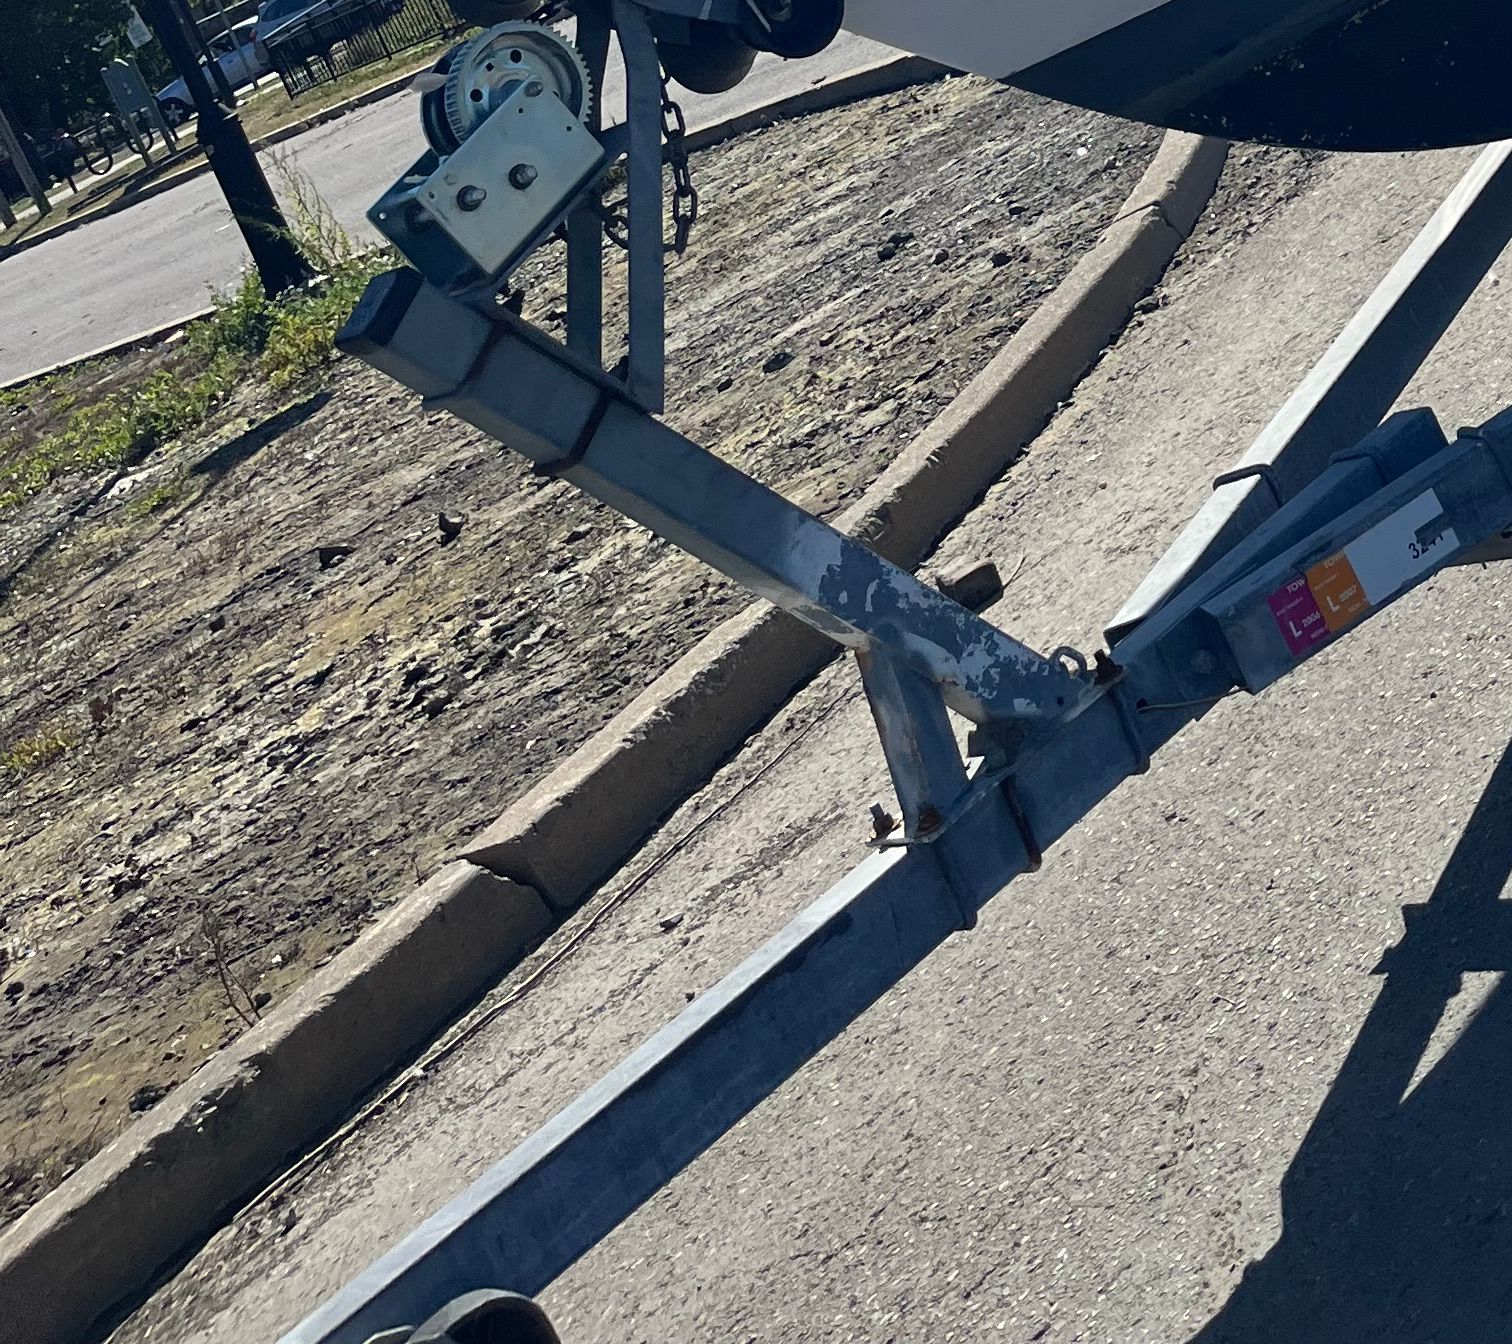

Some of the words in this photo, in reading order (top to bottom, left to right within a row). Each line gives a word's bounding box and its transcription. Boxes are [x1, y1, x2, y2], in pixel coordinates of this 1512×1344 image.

[1408, 534, 1444, 559] 32
[1326, 595, 1340, 612] L
[1289, 620, 1303, 638] L
